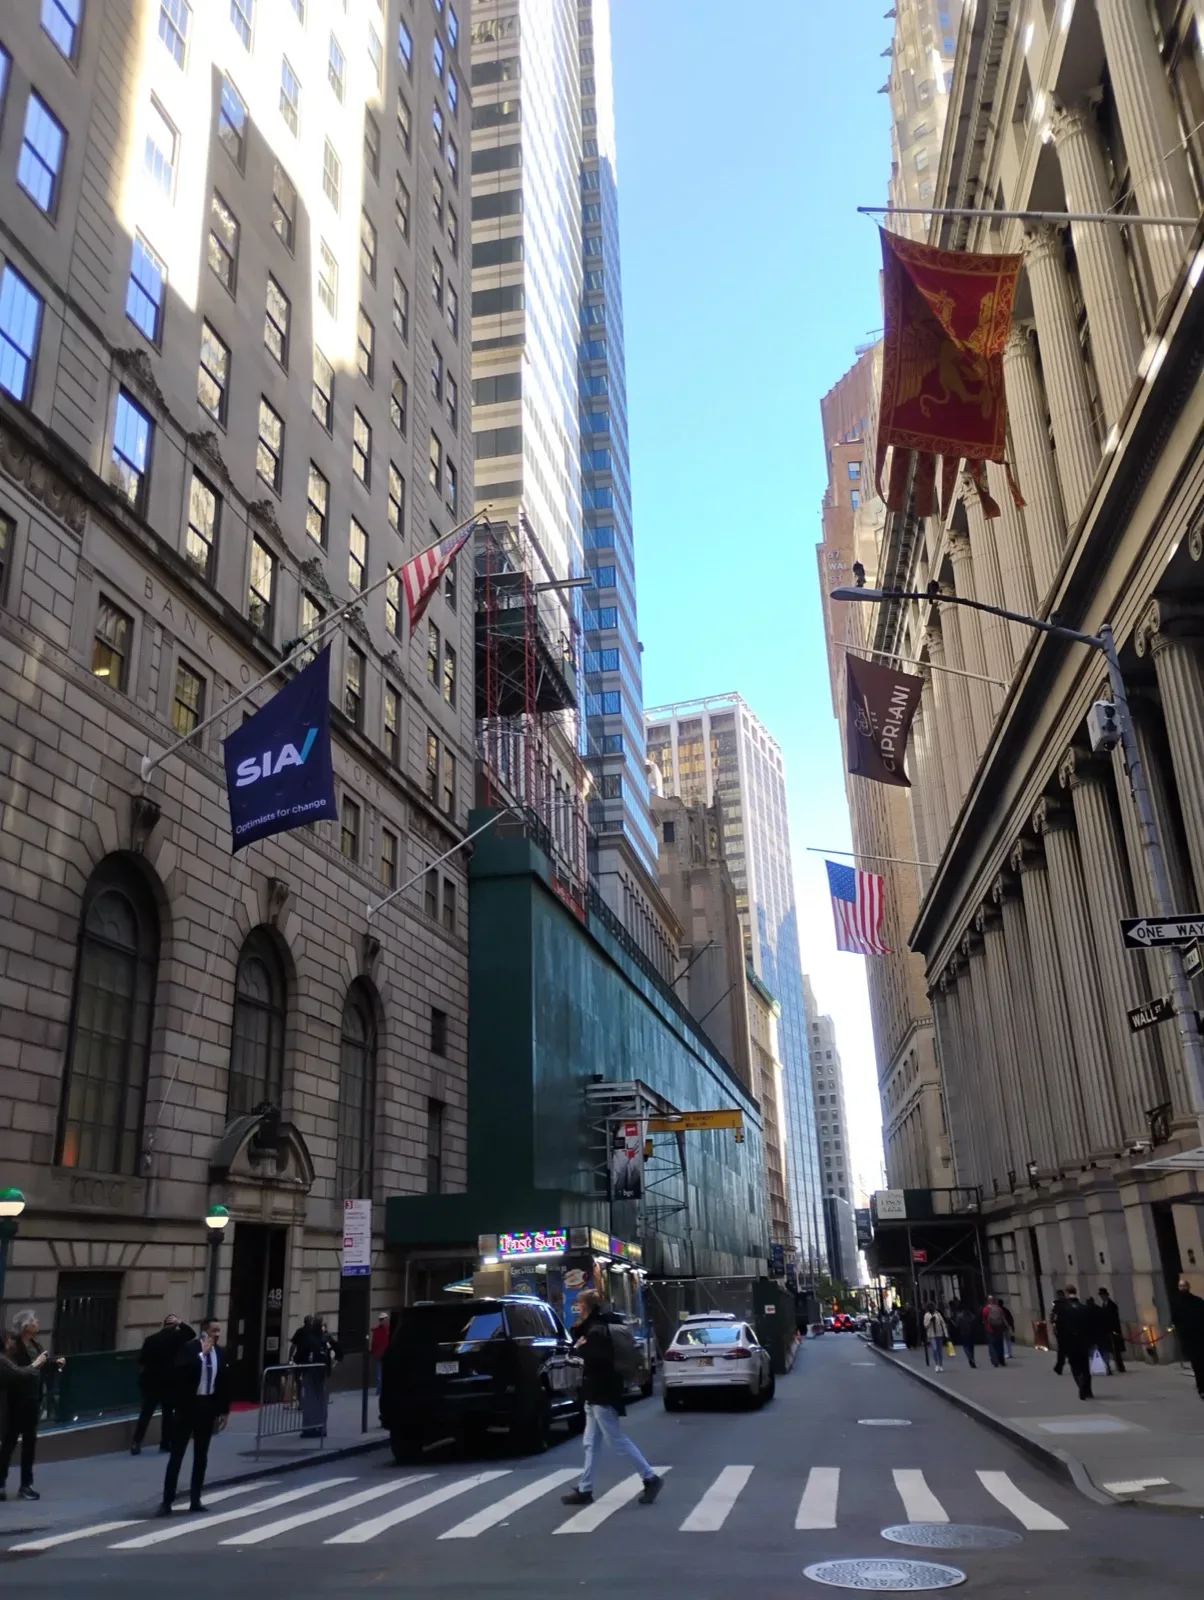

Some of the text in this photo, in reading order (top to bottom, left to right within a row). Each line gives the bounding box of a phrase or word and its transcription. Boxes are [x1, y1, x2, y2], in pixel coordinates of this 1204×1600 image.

[143, 576, 215, 655] BANK
[880, 685, 911, 772] CIPRIANI
[235, 799, 327, 834] Optimists for change
[1137, 923, 1204, 938] ONE WAY
[1132, 1009, 1158, 1028] WALL
[1154, 1004, 1162, 1014] ST
[268, 1288, 282, 1300] 48
